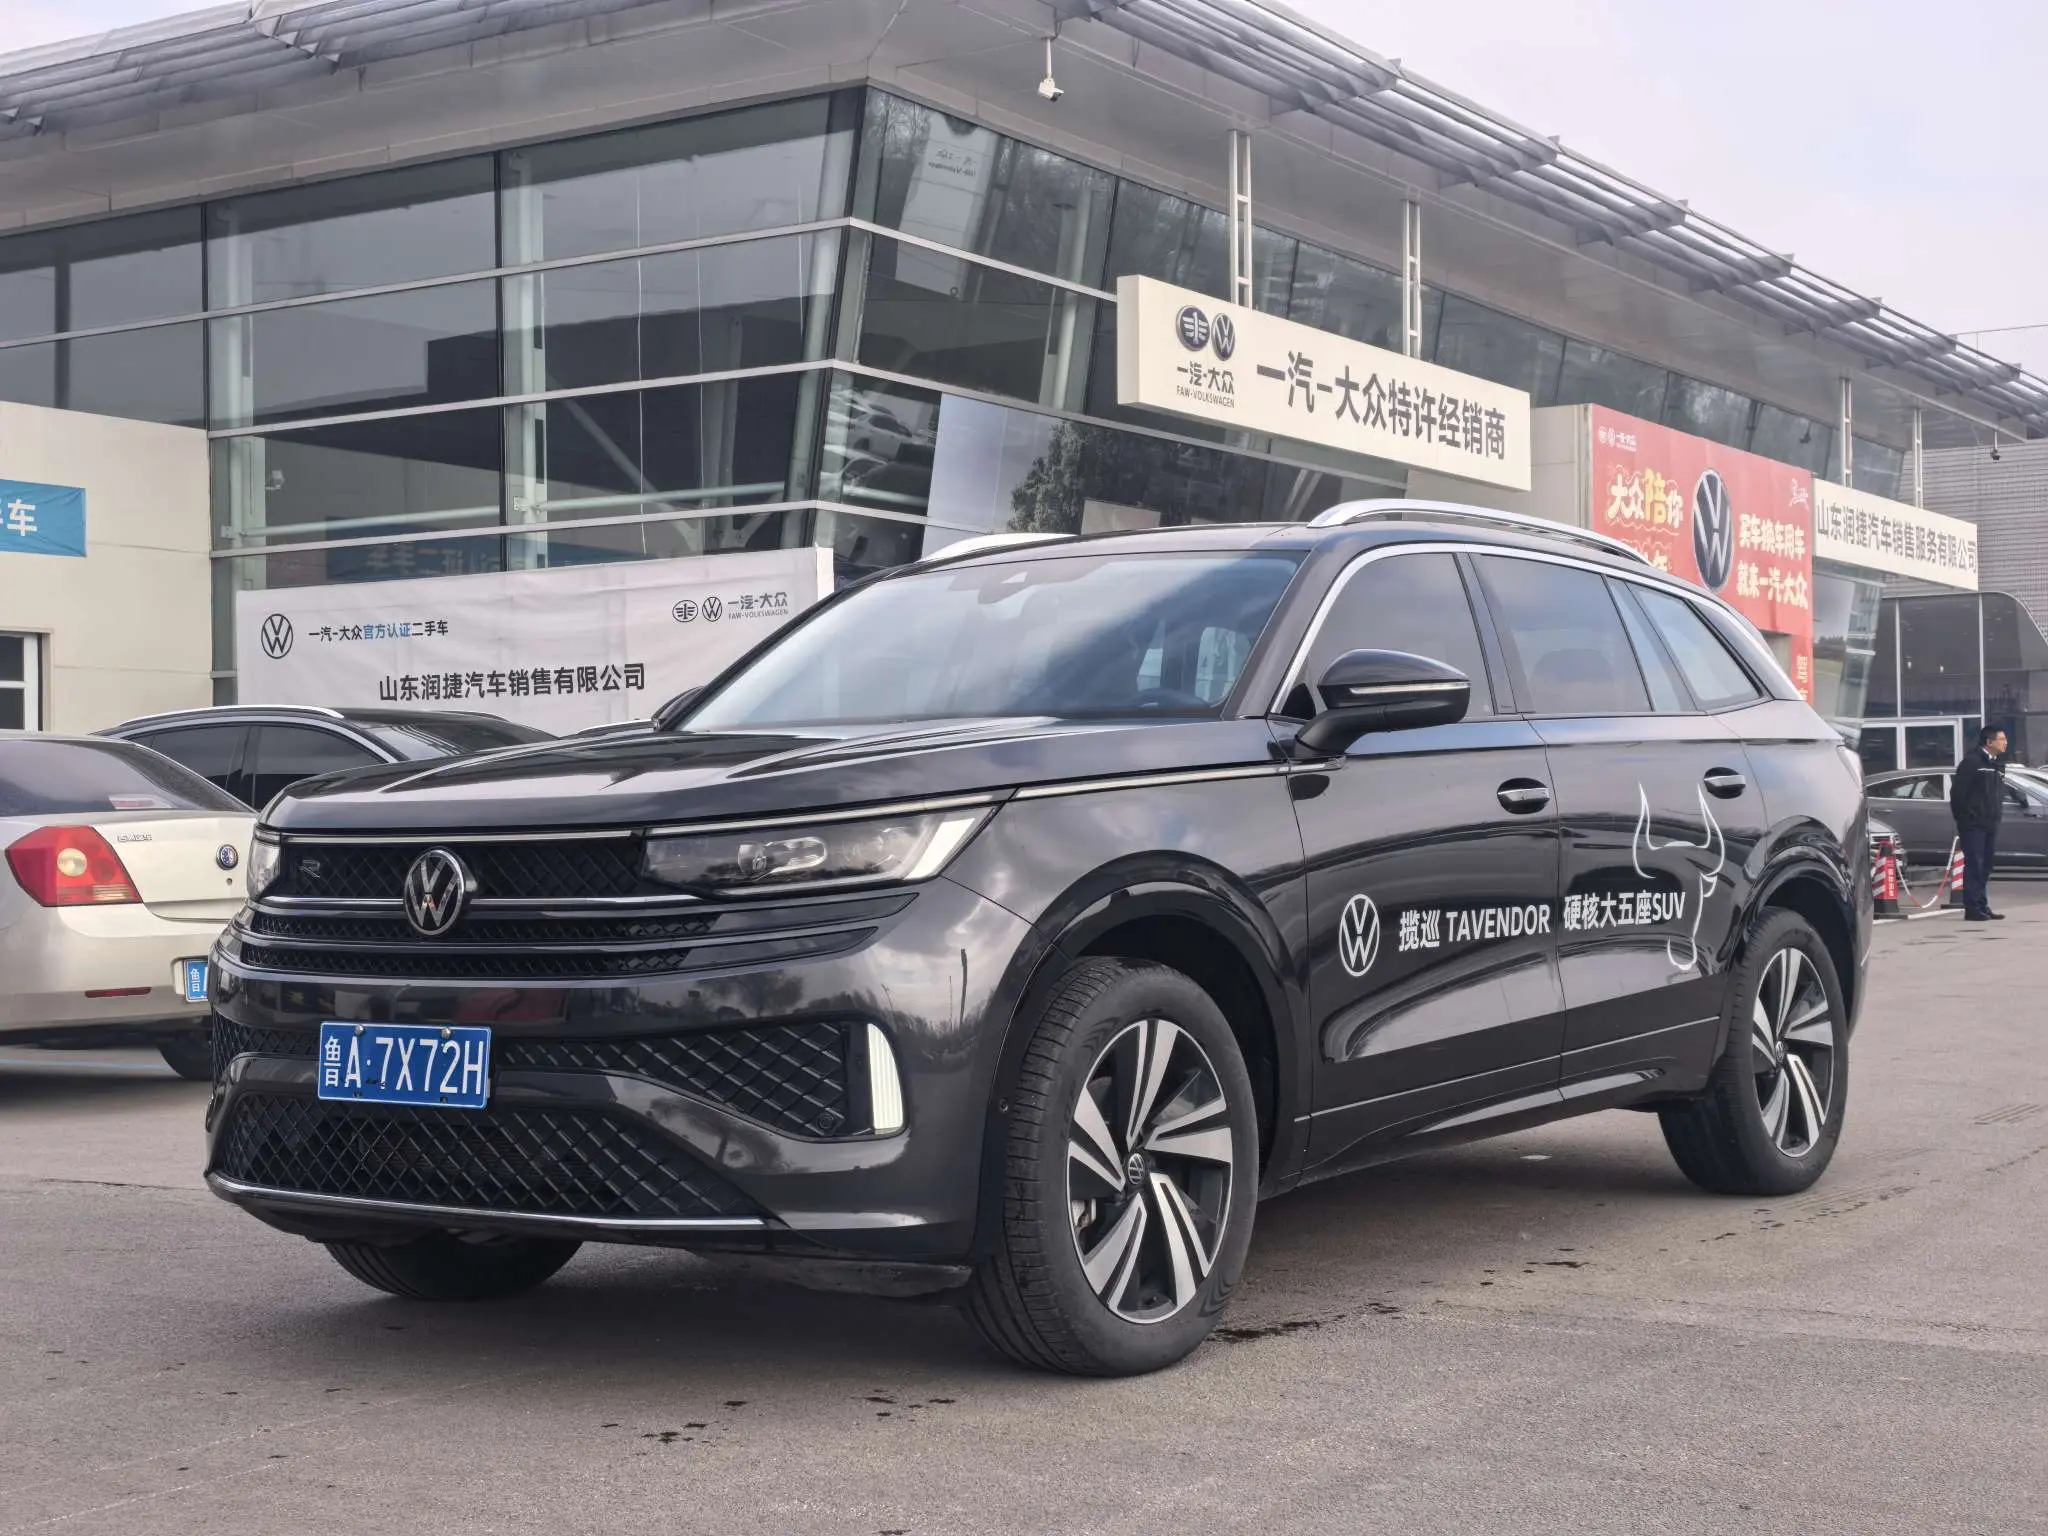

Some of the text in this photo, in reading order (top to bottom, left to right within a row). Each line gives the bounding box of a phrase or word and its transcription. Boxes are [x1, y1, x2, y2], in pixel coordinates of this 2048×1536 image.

[1257, 350, 1506, 460] 一汽-大众特许经销商
[0, 499, 37, 537] 车
[1816, 498, 1977, 573] 山东润捷汽车销售服务有限公司
[308, 620, 449, 642] 一汽-大众官方认证二手车
[379, 662, 645, 702] 山东润捷汽车销售有限公司
[1399, 891, 1686, 952] 揽巡 TAVENDOR 硬核大五座SUV
